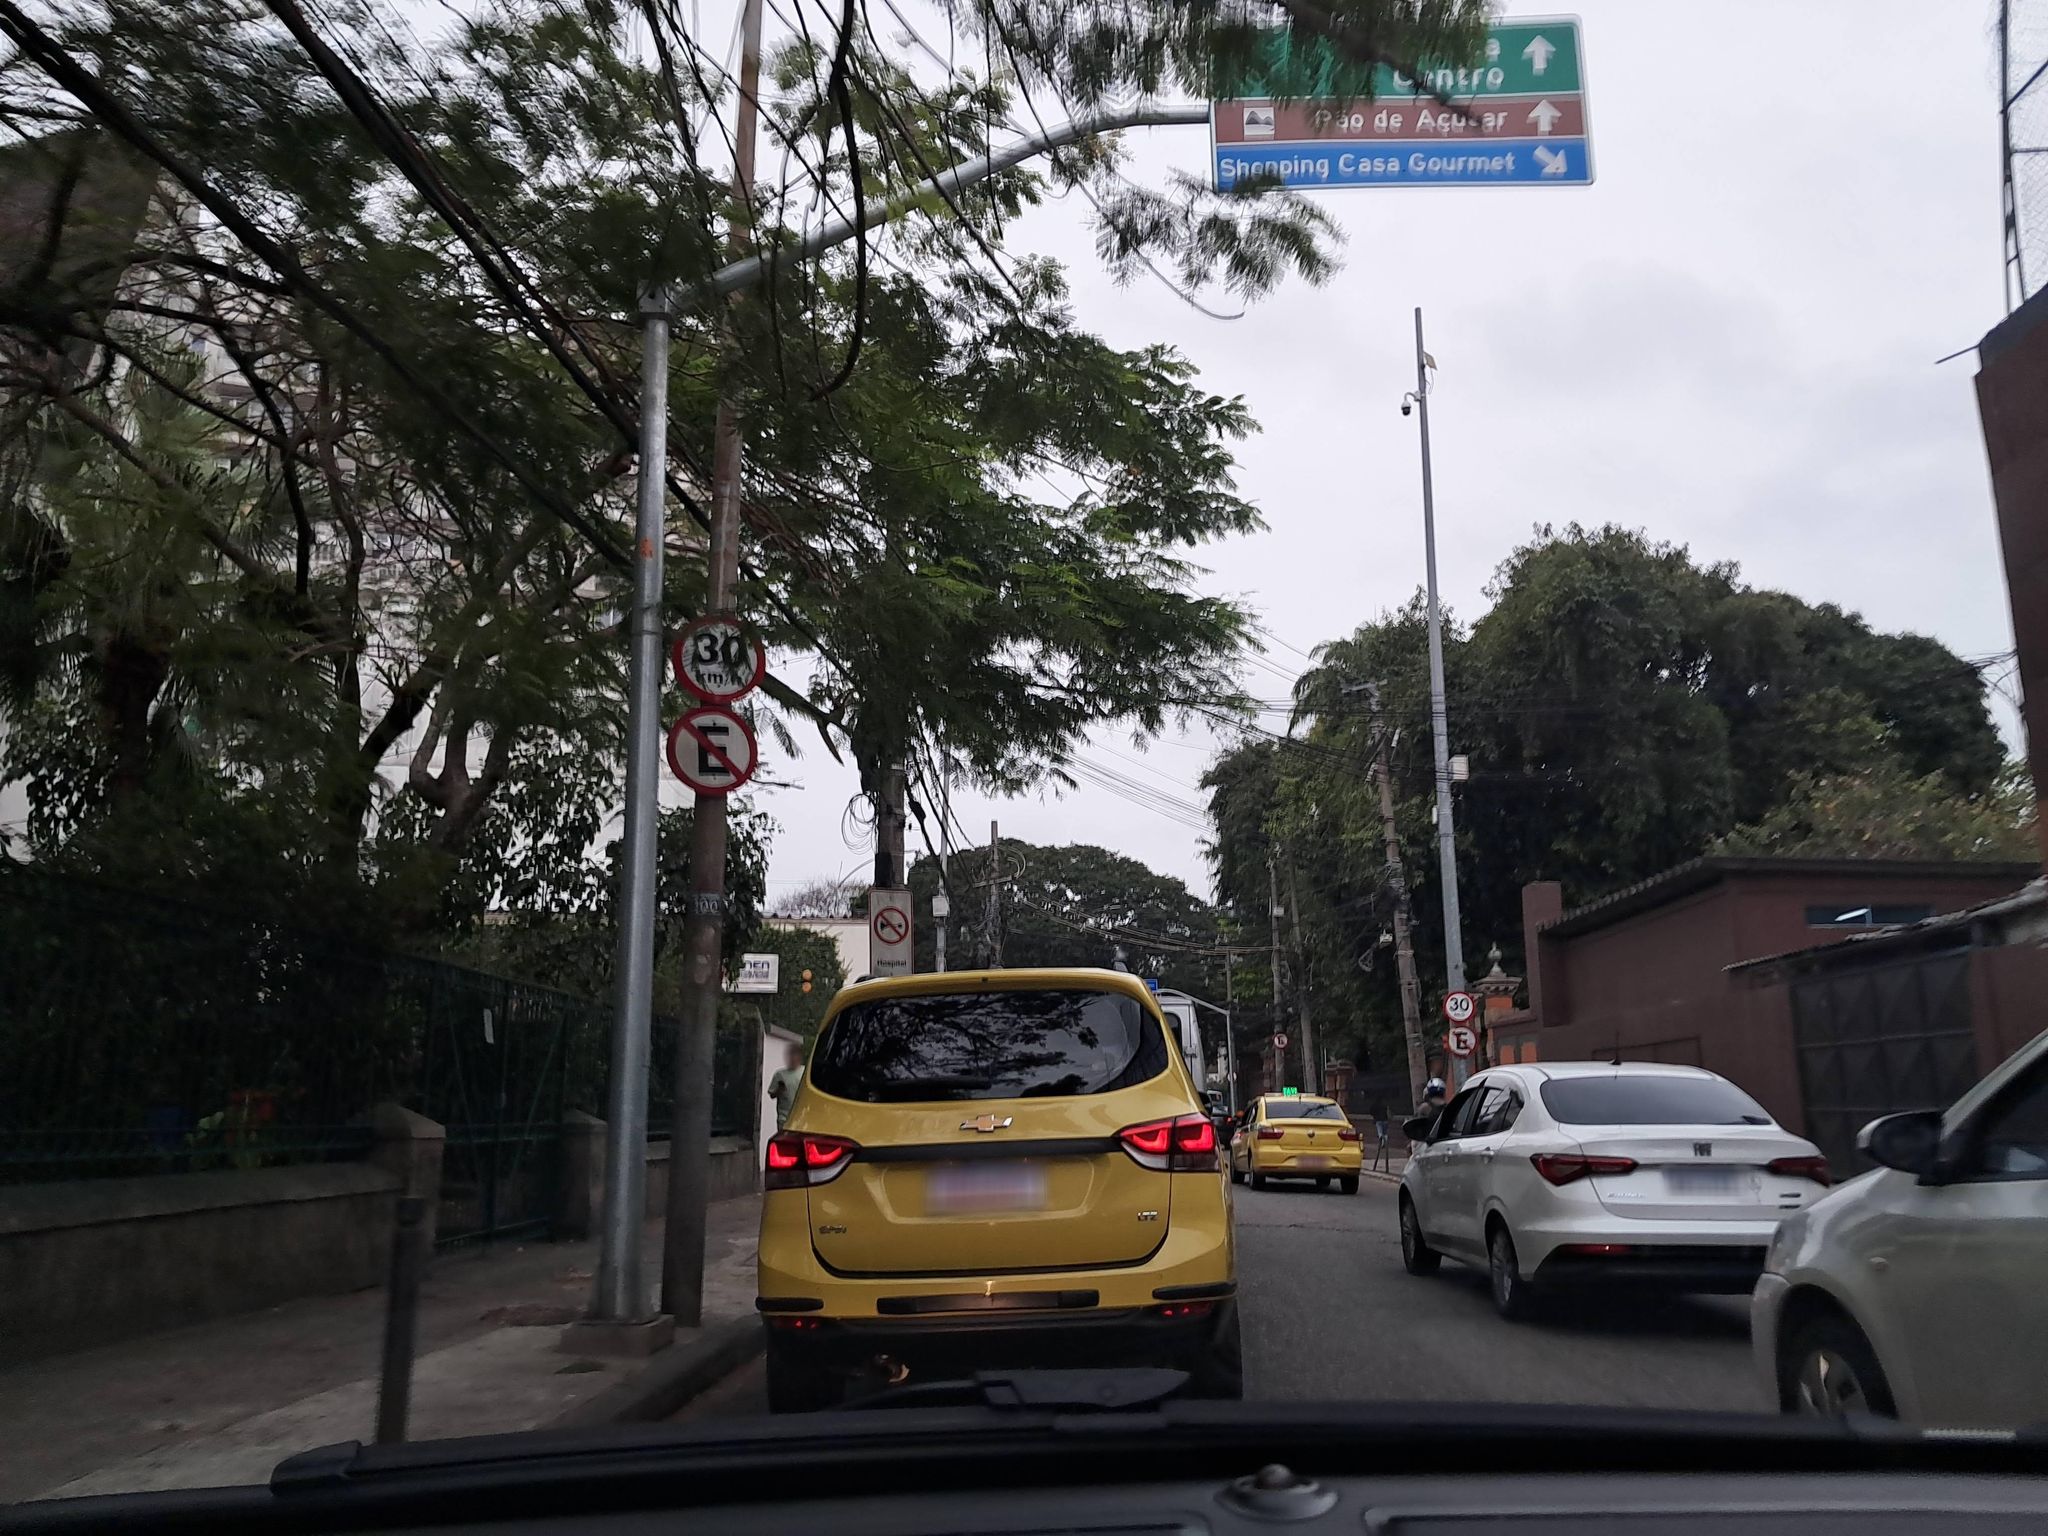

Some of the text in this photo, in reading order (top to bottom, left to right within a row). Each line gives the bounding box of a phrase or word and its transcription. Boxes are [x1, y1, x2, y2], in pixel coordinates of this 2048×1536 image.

[1374, 109, 1403, 130] de
[1220, 152, 1516, 178] Shopping Casa Gourmet
[697, 633, 742, 665] 30
[698, 726, 730, 775] E
[1450, 997, 1470, 1012] 30
